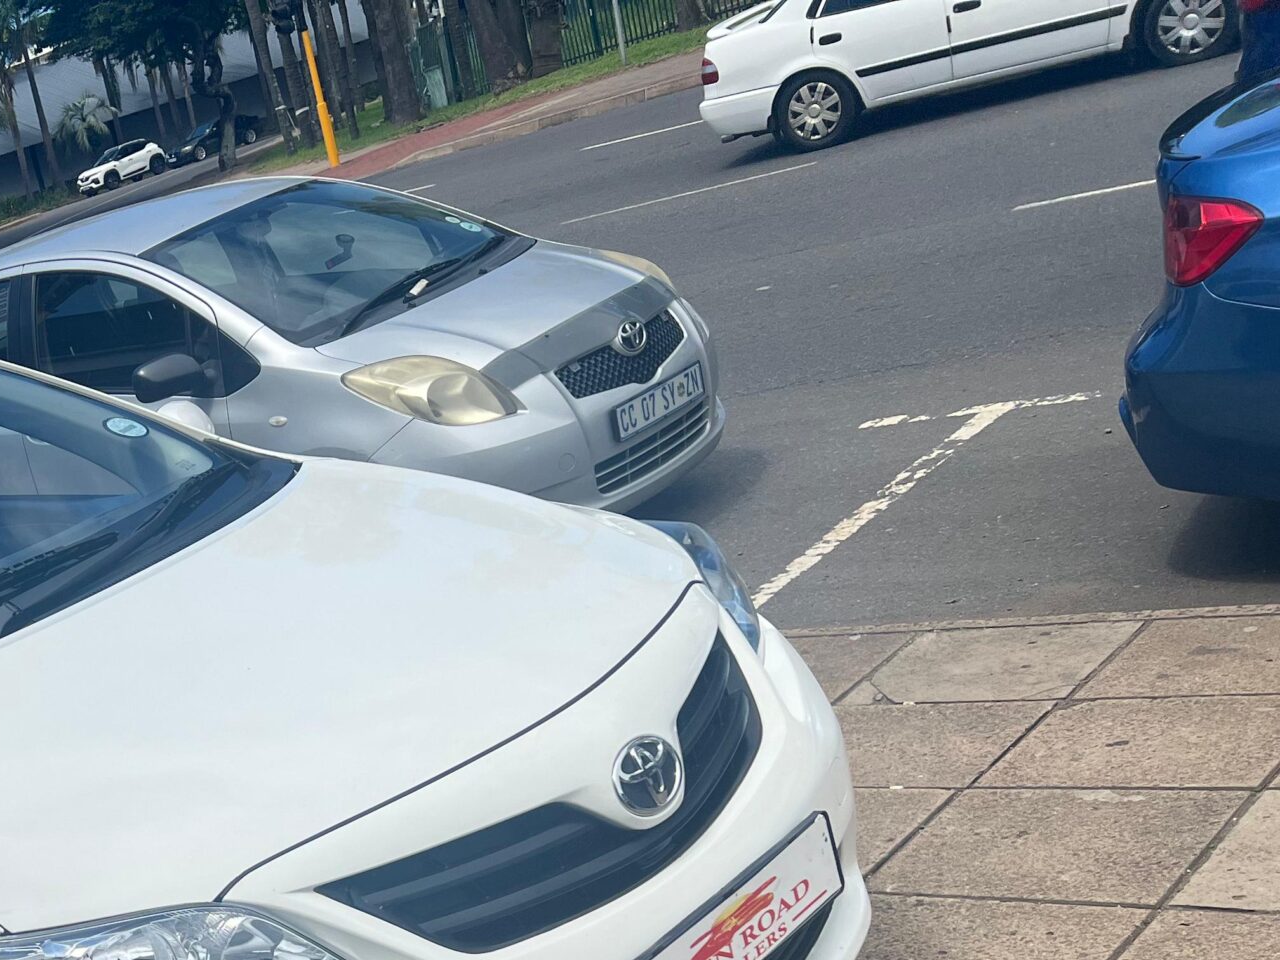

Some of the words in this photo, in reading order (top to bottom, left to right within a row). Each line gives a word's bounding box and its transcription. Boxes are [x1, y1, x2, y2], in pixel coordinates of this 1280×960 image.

[620, 404, 637, 433] CC
[641, 393, 656, 421] 07
[661, 382, 676, 411] SY
[684, 368, 700, 397] ZN
[739, 878, 810, 950] ROAD
